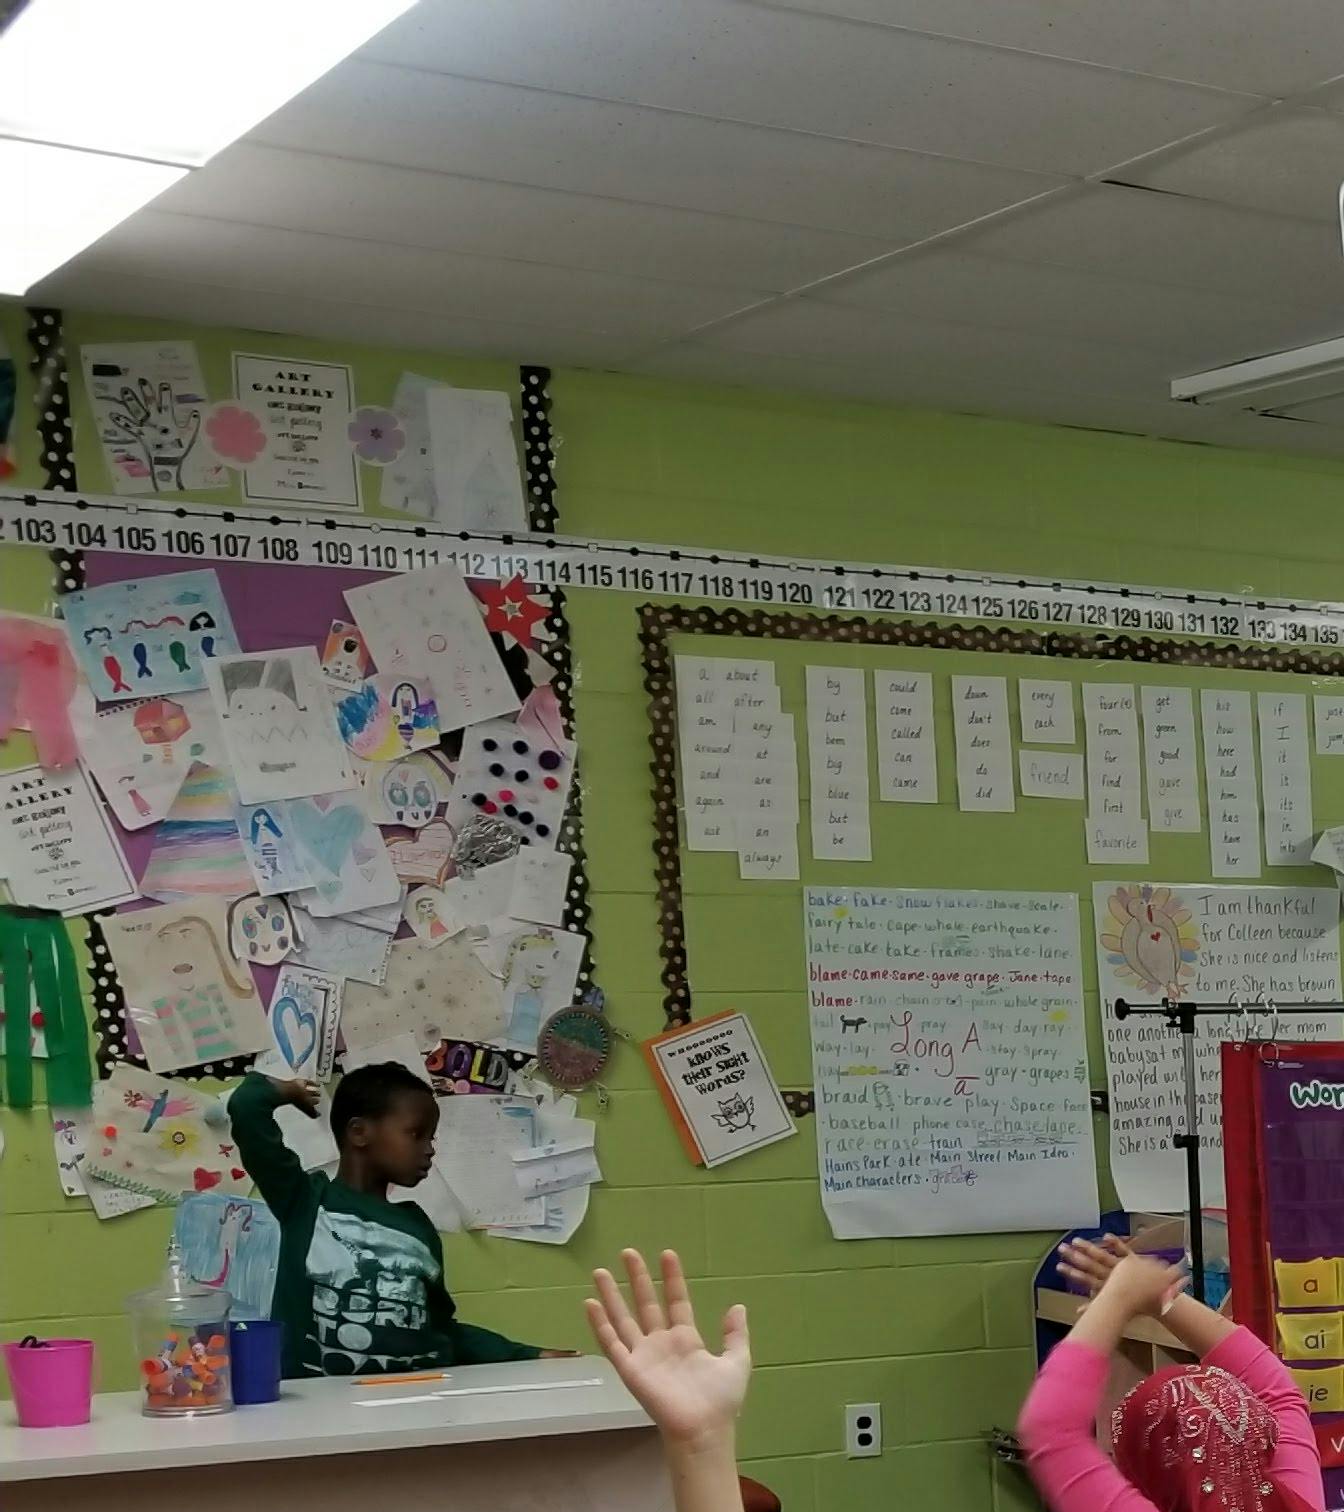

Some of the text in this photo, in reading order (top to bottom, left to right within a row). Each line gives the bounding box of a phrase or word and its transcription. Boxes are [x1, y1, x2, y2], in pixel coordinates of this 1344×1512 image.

[276, 372, 311, 381] ART
[252, 383, 334, 399] GALLERY
[12, 518, 56, 543] 103
[63, 522, 106, 548] 104
[112, 526, 156, 552] 105
[210, 533, 250, 558] 107
[258, 537, 299, 561] 108
[312, 541, 352, 566] 109
[358, 544, 396, 569] 110
[534, 559, 571, 583] 114
[576, 562, 612, 586] 115
[660, 571, 693, 594] 117
[698, 574, 734, 597] 118
[776, 581, 812, 604] 120
[862, 588, 894, 610] 122
[899, 591, 931, 613] 123
[936, 594, 968, 615] 124
[971, 596, 1003, 618] 125
[1007, 599, 1039, 621] 126
[1111, 607, 1141, 629] 129
[1144, 609, 1174, 631] 130
[1210, 614, 1240, 636] 132
[825, 676, 841, 695] by
[826, 708, 847, 722] but
[1030, 765, 1070, 786] friend
[1095, 829, 1138, 849] favorite
[1198, 894, 1316, 916] I am thankful
[1200, 922, 1326, 942] for Colleen because
[1244, 951, 1268, 964] nice
[1272, 948, 1297, 964] and
[1196, 972, 1210, 992] to
[1270, 976, 1294, 991] has
[1298, 975, 1335, 992] brown
[1108, 1022, 1327, 1043] one mom
[890, 1010, 982, 1078] Long A
[1112, 1066, 1158, 1092] played
[822, 1086, 868, 1105] braid
[1114, 1094, 1166, 1113] house in
[1113, 1115, 1173, 1139] amazing
[1008, 1150, 1036, 1161] Main
[824, 1178, 852, 1193] Main
[1304, 1276, 1318, 1294] a
[1304, 1330, 1326, 1350] ai
